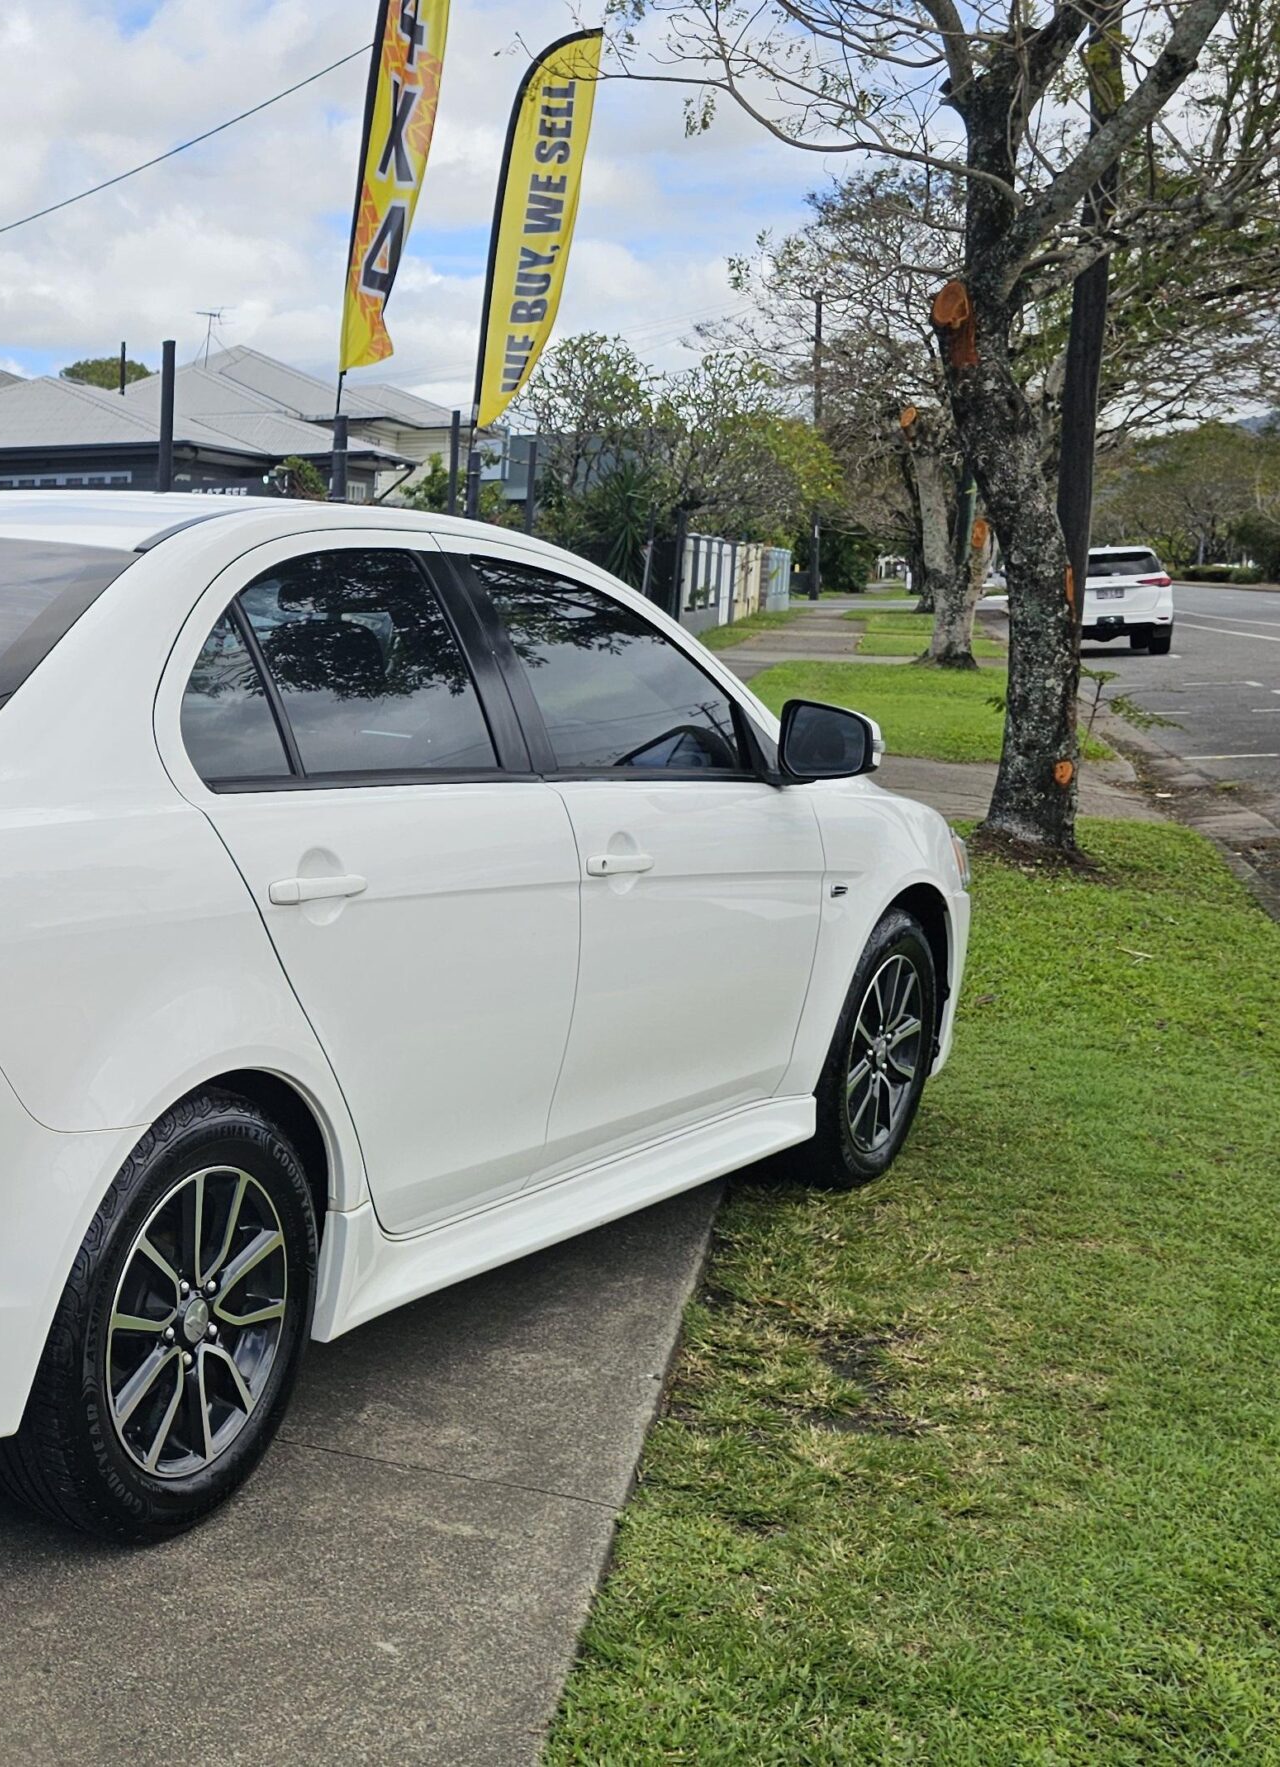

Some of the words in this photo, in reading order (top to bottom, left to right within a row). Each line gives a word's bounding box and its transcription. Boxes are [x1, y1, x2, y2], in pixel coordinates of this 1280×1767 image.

[534, 81, 576, 165] SELL
[523, 173, 568, 235] WE
[510, 245, 561, 325] BUY,
